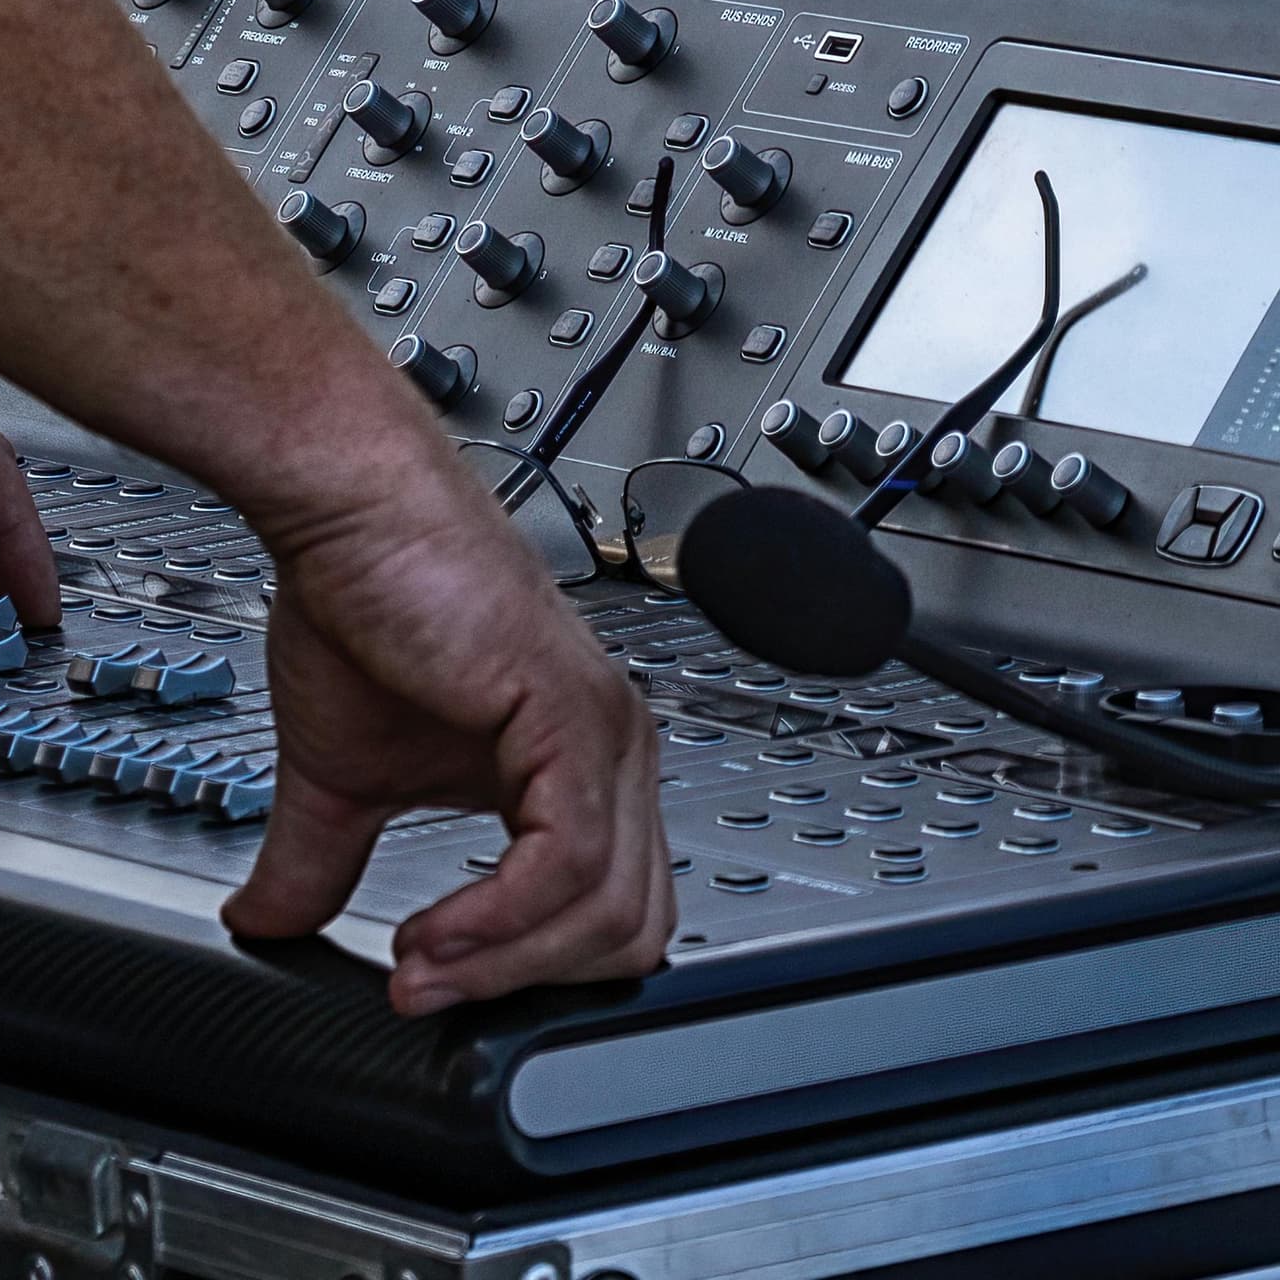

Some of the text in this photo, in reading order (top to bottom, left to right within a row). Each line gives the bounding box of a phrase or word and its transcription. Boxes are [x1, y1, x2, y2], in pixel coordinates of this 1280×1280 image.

[128, 12, 149, 25] GAIN
[720, 8, 777, 29] BUS SENDS
[239, 30, 287, 46] FREQUENCY
[905, 36, 962, 55] RECORDER
[422, 57, 451, 72] WIDTH
[827, 81, 858, 95] ACCESS
[445, 123, 475, 138] HIGH 2
[844, 151, 895, 170] MAIN BUS
[345, 167, 395, 184] FREQUENCY
[704, 226, 750, 245] M/C LEVEL
[371, 251, 389, 264] LOW
[640, 342, 677, 359] PAN/BAL
